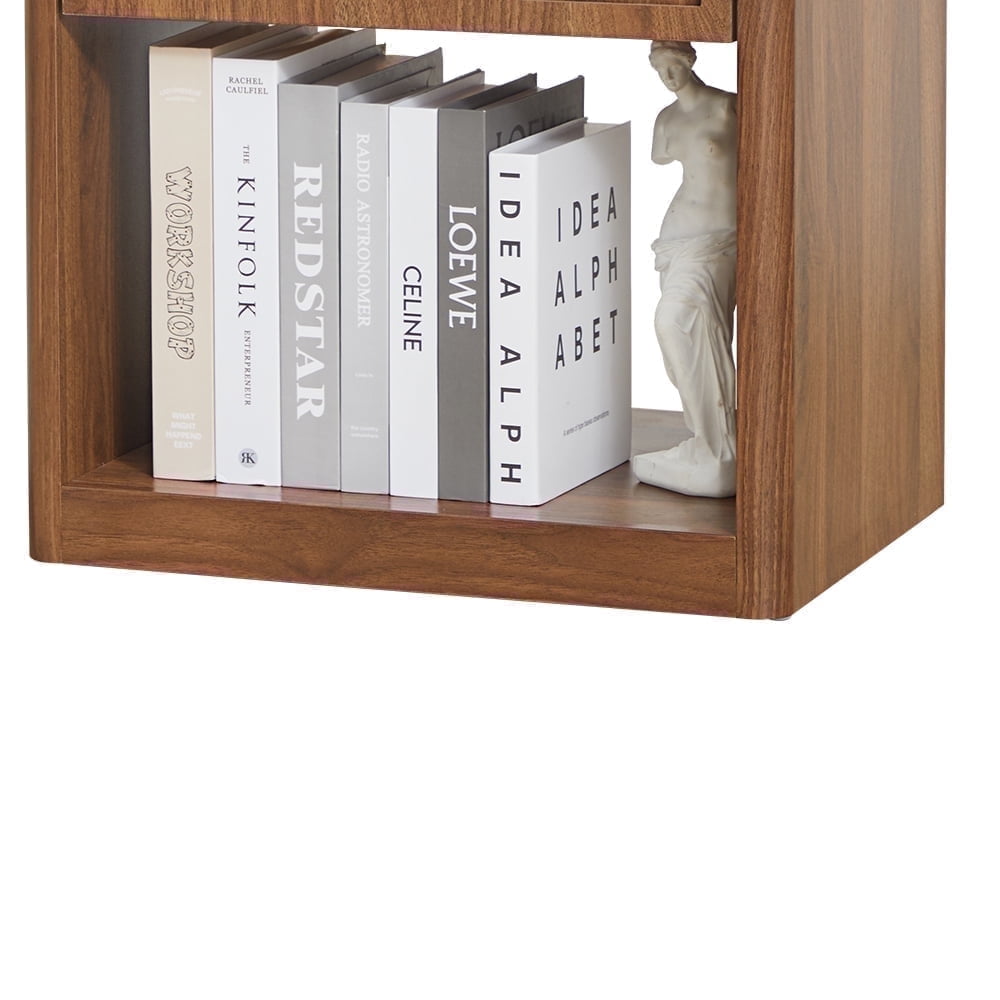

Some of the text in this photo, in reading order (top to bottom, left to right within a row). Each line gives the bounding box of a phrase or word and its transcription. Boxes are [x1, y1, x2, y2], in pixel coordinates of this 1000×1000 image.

[225, 86, 269, 95] CAULFIEL
[228, 76, 263, 85] RACHEL
[164, 165, 196, 361] WORKSHOP
[356, 132, 372, 328] RADIO ASTRONOMER
[448, 204, 477, 330] LOEWE
[557, 186, 618, 243] IDEA
[237, 145, 257, 406] THE KINFOLK ENTERPRENEUR
[293, 161, 326, 421] REDSTAR
[402, 265, 422, 352] CELINE
[499, 172, 522, 484] IDEA ALPH
[554, 246, 619, 307] ALPH
[555, 308, 619, 370] ABET
